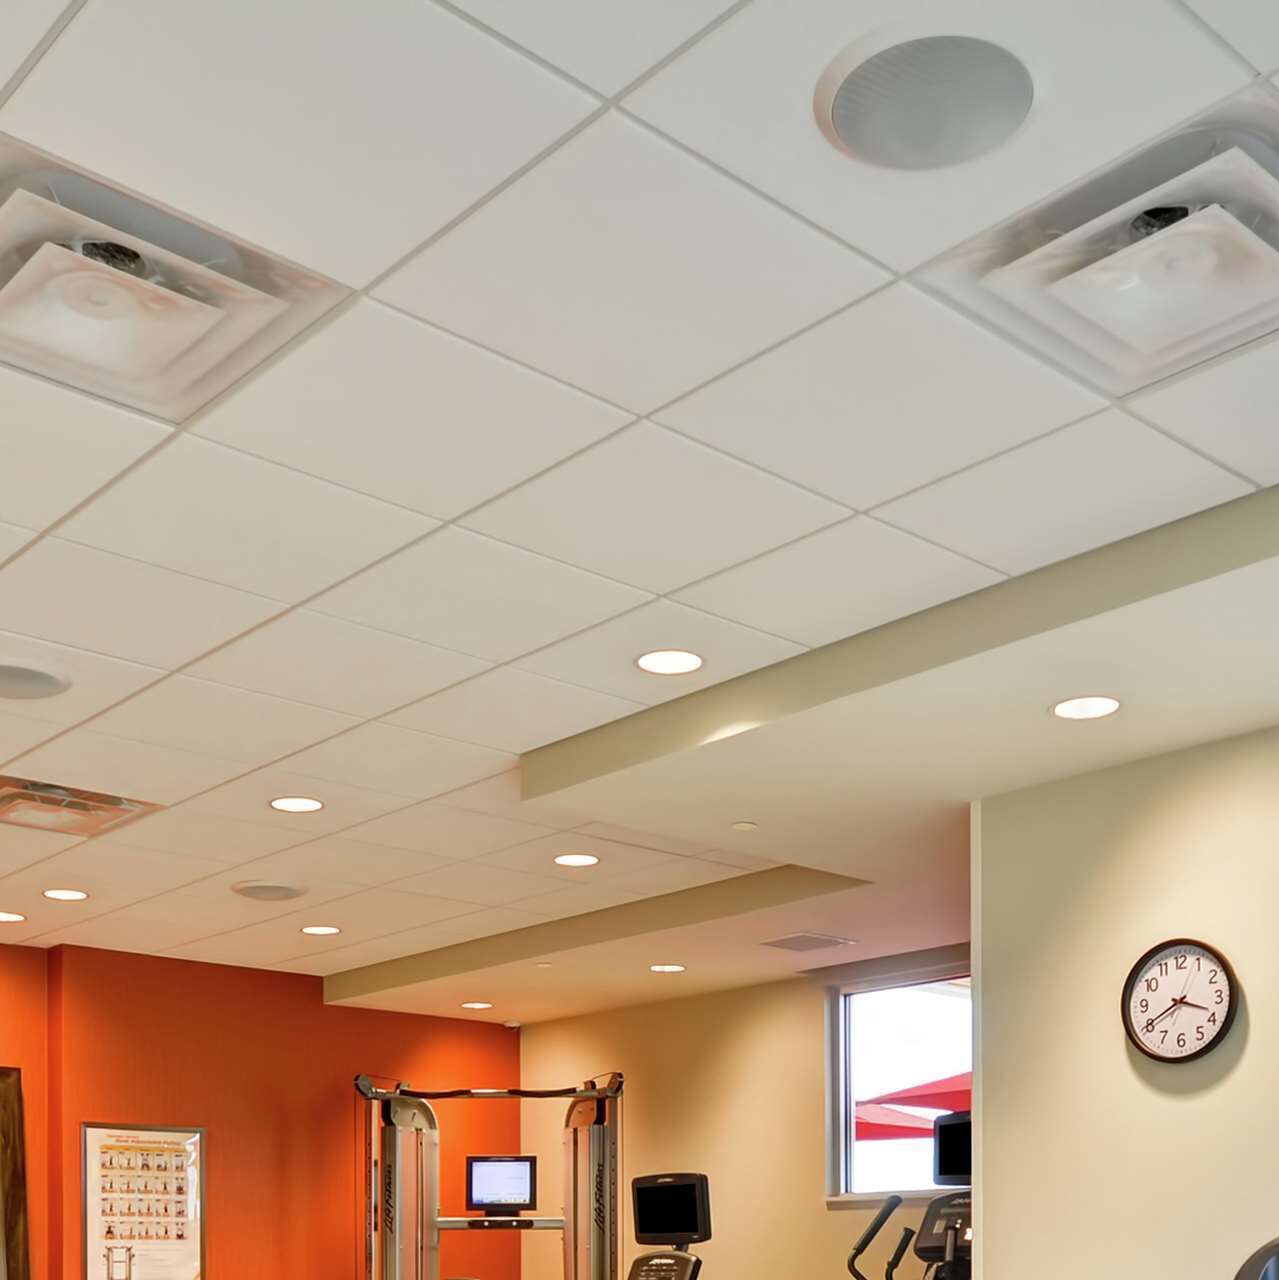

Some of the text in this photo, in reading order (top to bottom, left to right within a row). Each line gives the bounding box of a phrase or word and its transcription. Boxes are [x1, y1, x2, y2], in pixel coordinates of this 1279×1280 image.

[1158, 962, 1168, 976] 11
[1174, 955, 1187, 969] 12
[1195, 957, 1201, 971] 1
[1209, 969, 1218, 984] 2
[1145, 977, 1158, 992] 10
[1215, 990, 1224, 1004] 3
[1140, 999, 1149, 1013] 9
[1208, 1012, 1217, 1025] 4
[1146, 1019, 1155, 1033] 8
[1160, 1030, 1168, 1044] 7
[1177, 1033, 1186, 1048] 6
[1196, 1026, 1205, 1041] 5
